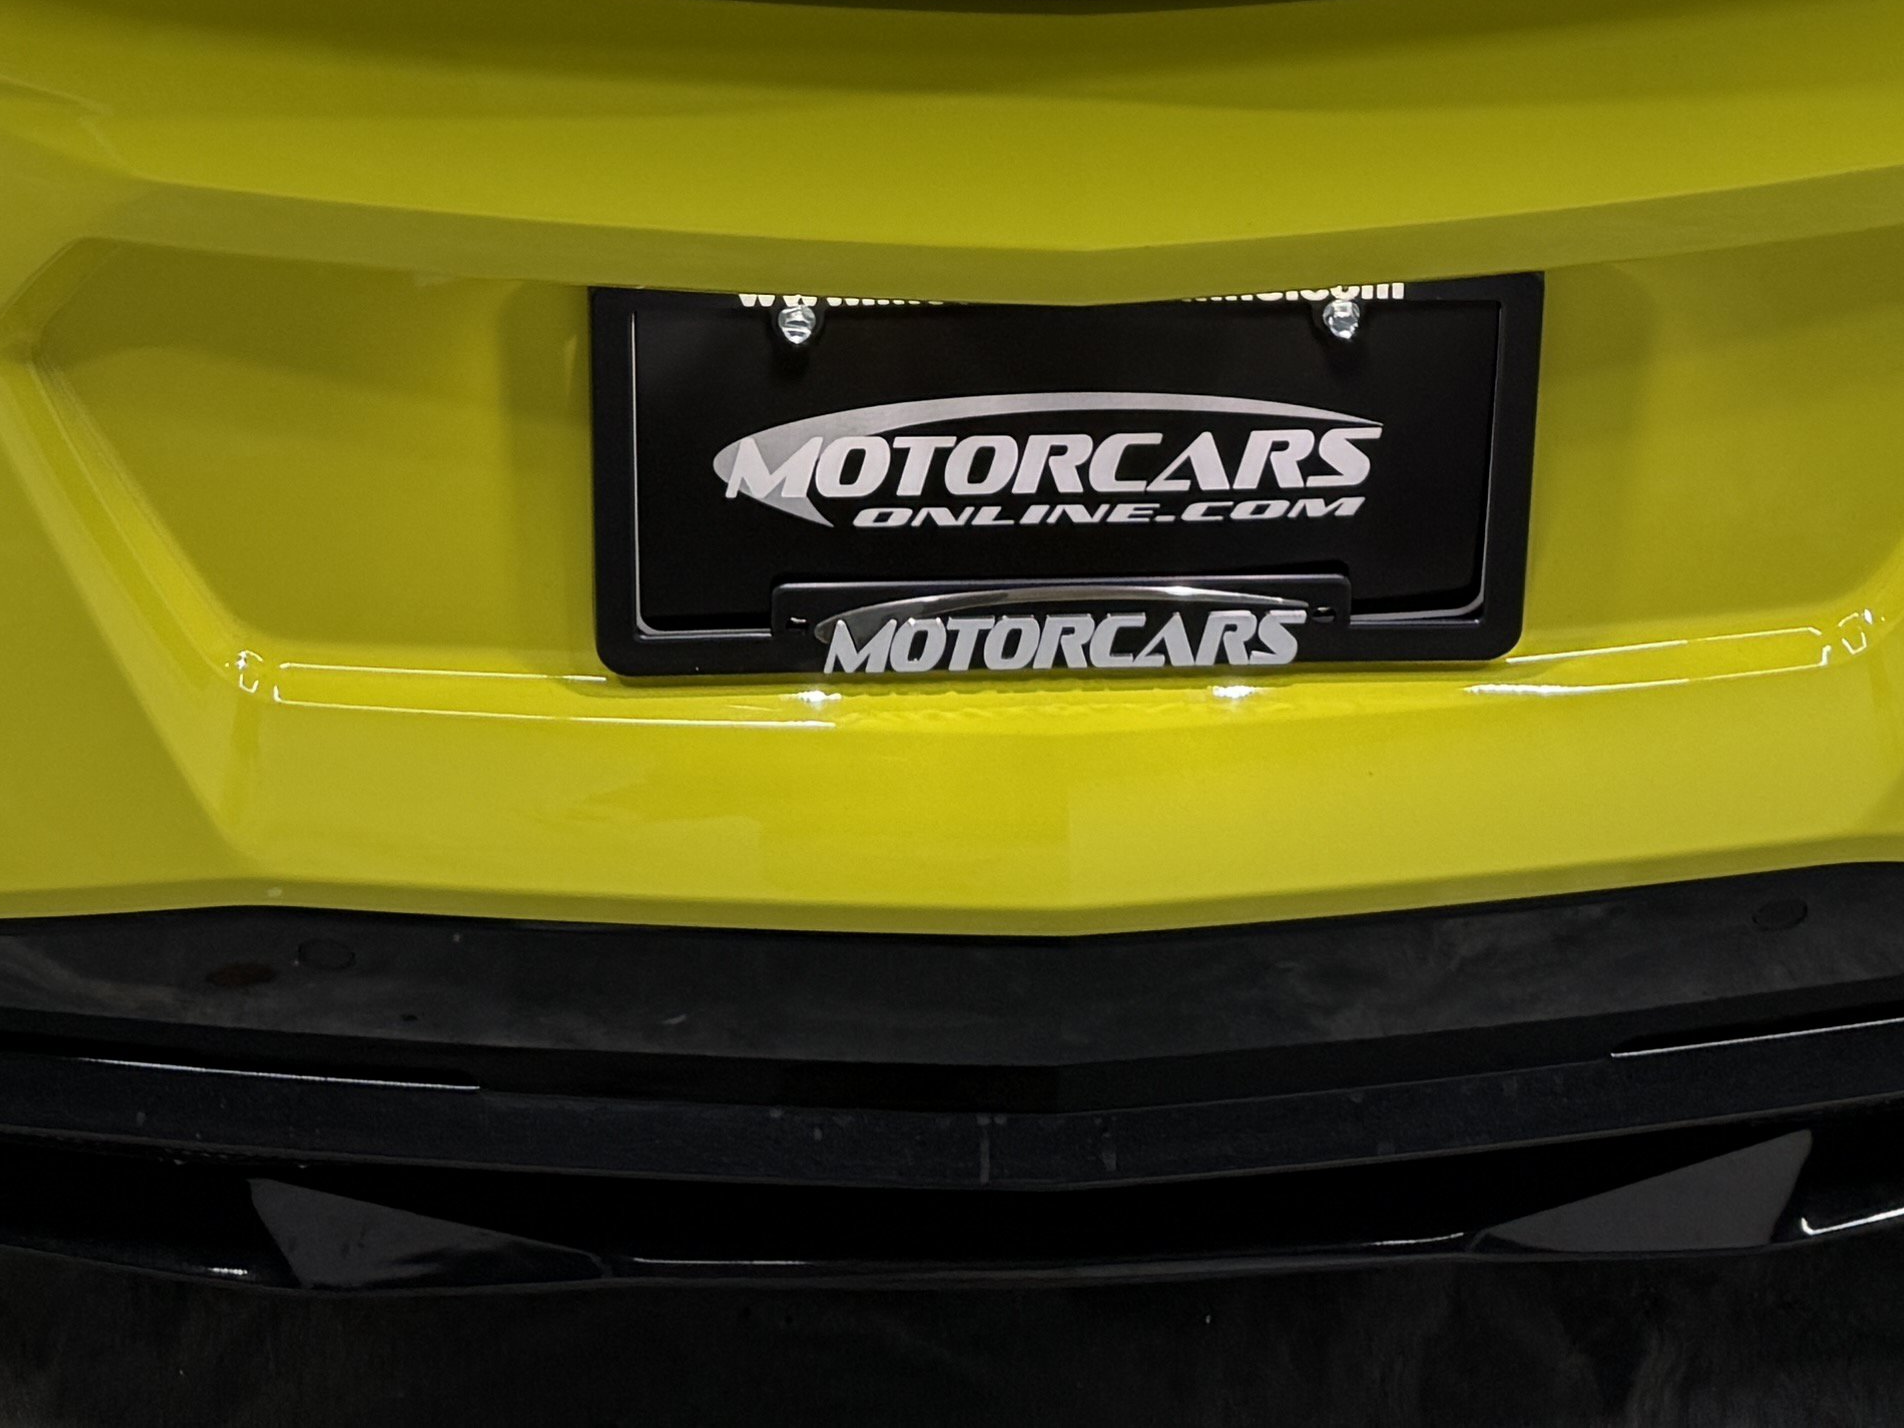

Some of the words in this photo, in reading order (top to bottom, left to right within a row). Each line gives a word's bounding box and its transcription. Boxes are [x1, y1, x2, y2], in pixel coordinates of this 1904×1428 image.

[725, 426, 1383, 499] MOTORCARS
[852, 496, 1366, 528] ONLINE.COM
[823, 609, 1308, 674] MOTORCARS
